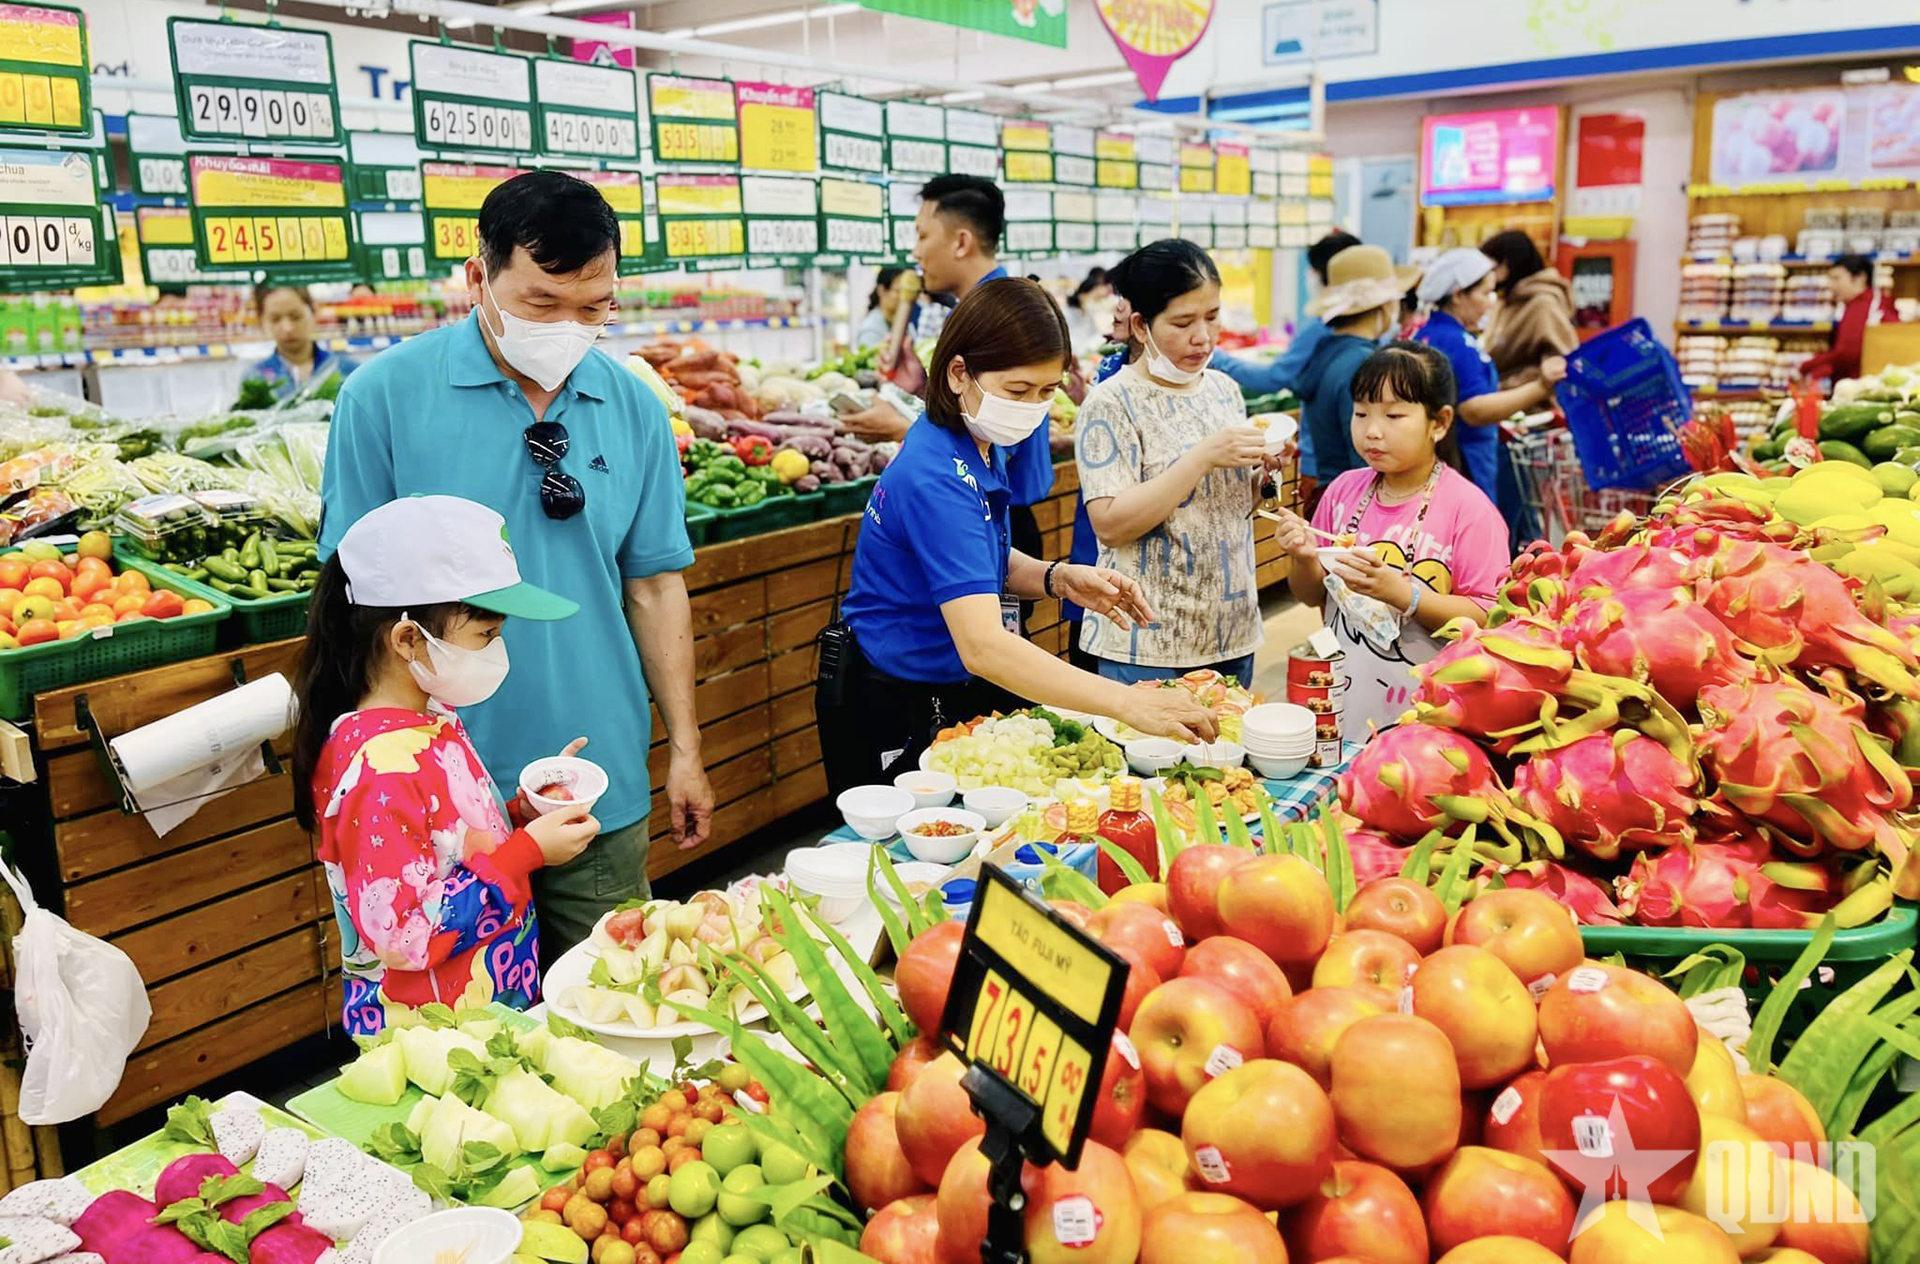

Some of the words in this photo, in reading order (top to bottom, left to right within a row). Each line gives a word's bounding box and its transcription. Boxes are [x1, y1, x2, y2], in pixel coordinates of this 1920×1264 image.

[197, 93, 307, 126] 29.900
[430, 108, 510, 138] 62.500
[195, 155, 246, 172] Khuyến
[0, 223, 60, 255] 00
[1032, 936, 1054, 962] FUJI
